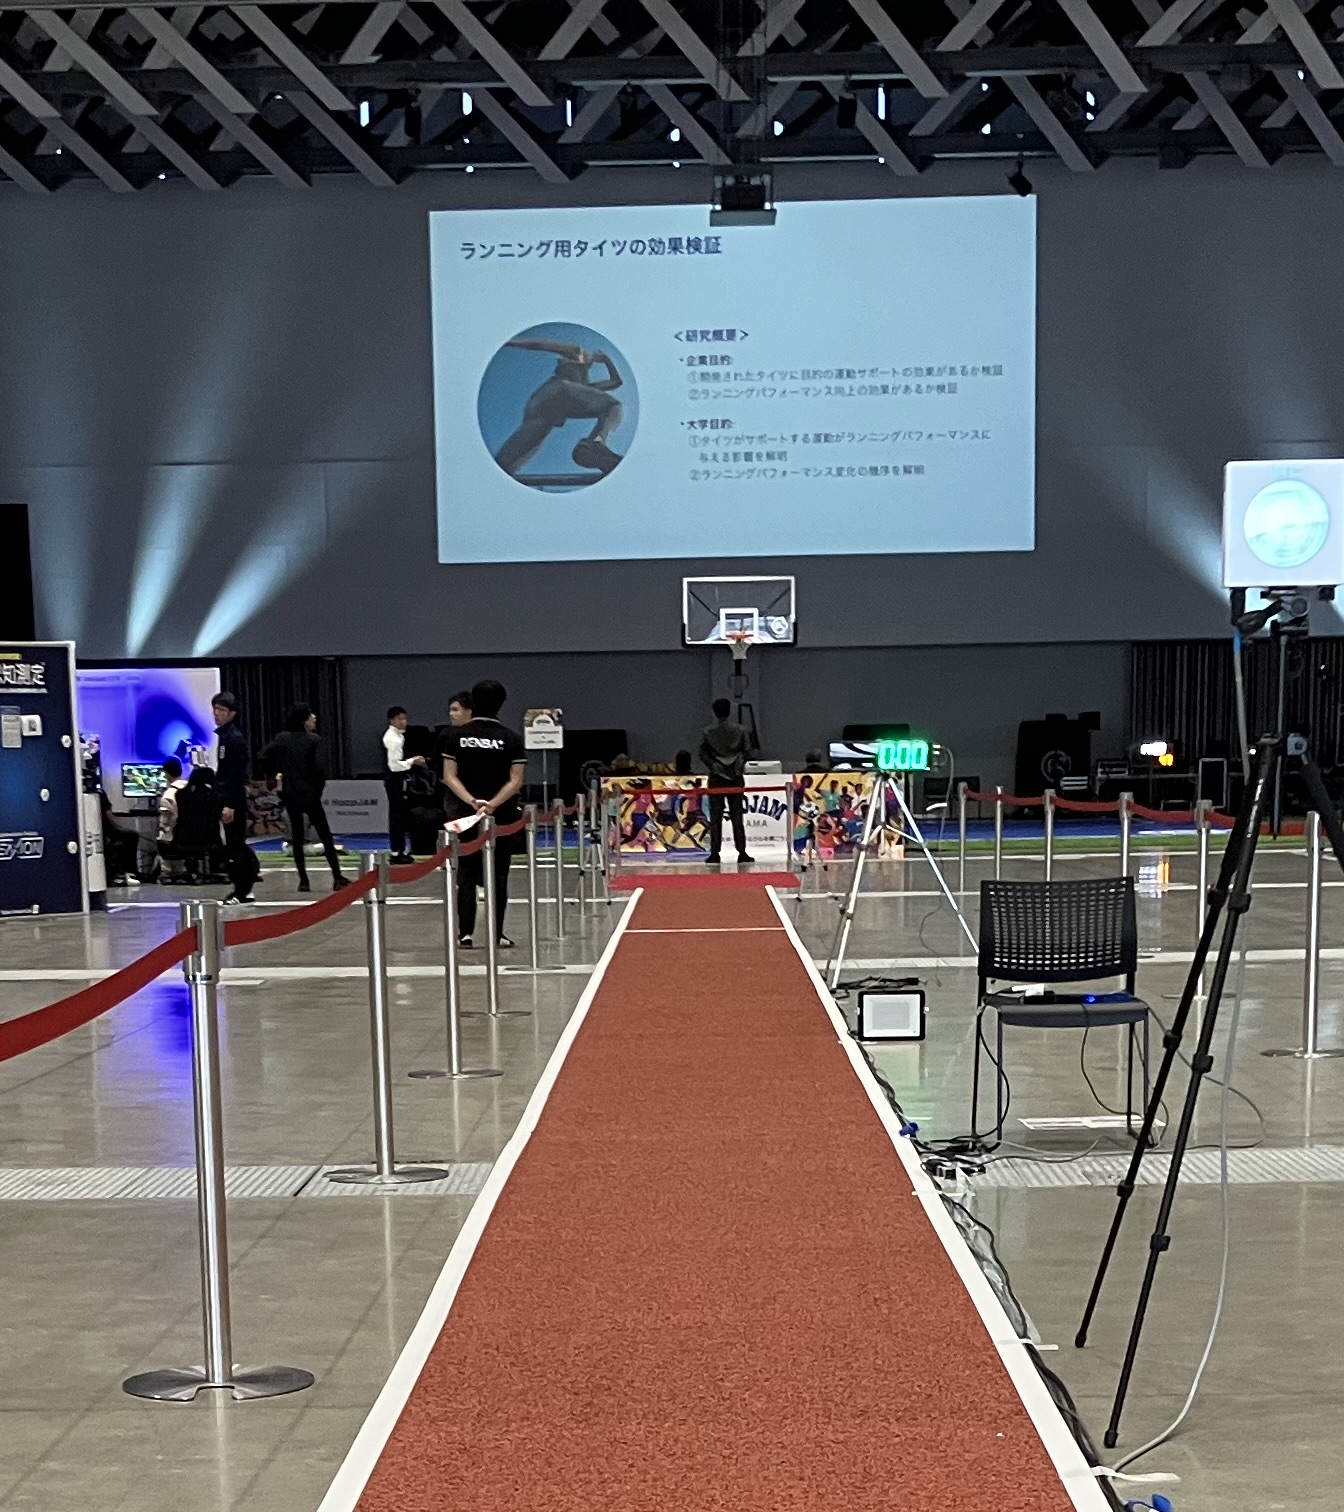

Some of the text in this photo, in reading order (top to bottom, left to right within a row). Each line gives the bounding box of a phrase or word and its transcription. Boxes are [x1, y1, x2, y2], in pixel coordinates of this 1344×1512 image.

[460, 236, 722, 260] ランニング用タイツの効果検証
